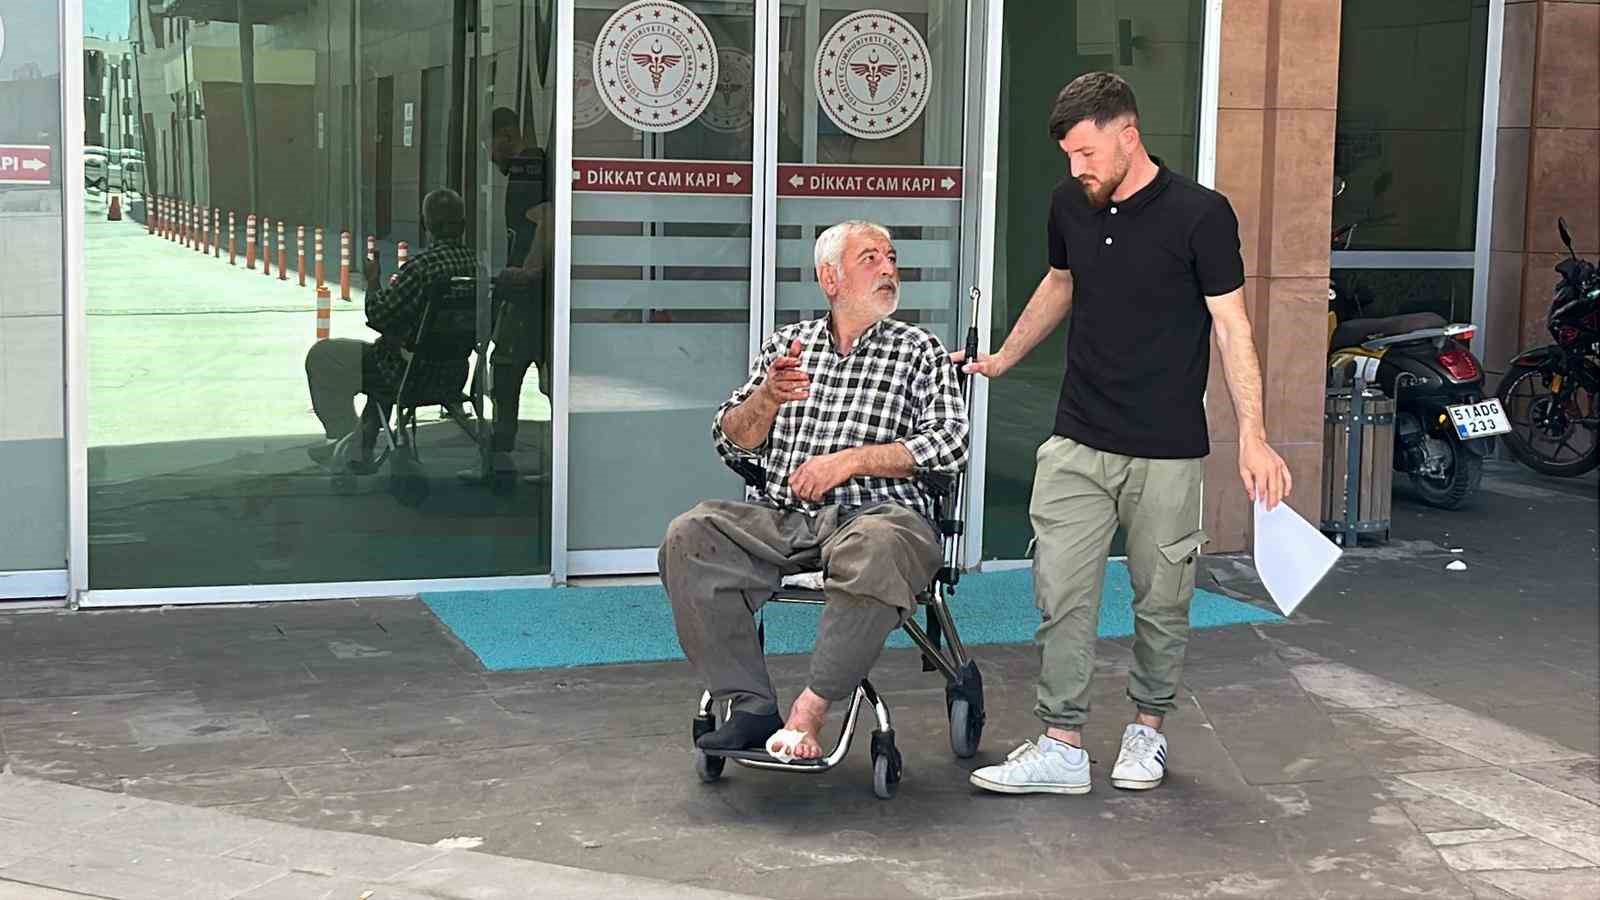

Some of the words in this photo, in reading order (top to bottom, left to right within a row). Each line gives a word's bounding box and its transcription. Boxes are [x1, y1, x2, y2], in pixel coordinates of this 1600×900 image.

[586, 167, 644, 185] DİKKAT
[647, 171, 681, 186] CAM
[685, 172, 720, 187] KAPI
[810, 173, 863, 190] DİKKAT
[866, 176, 898, 191] CAM
[902, 177, 935, 191] KAPI
[1469, 419, 1496, 433] 233
